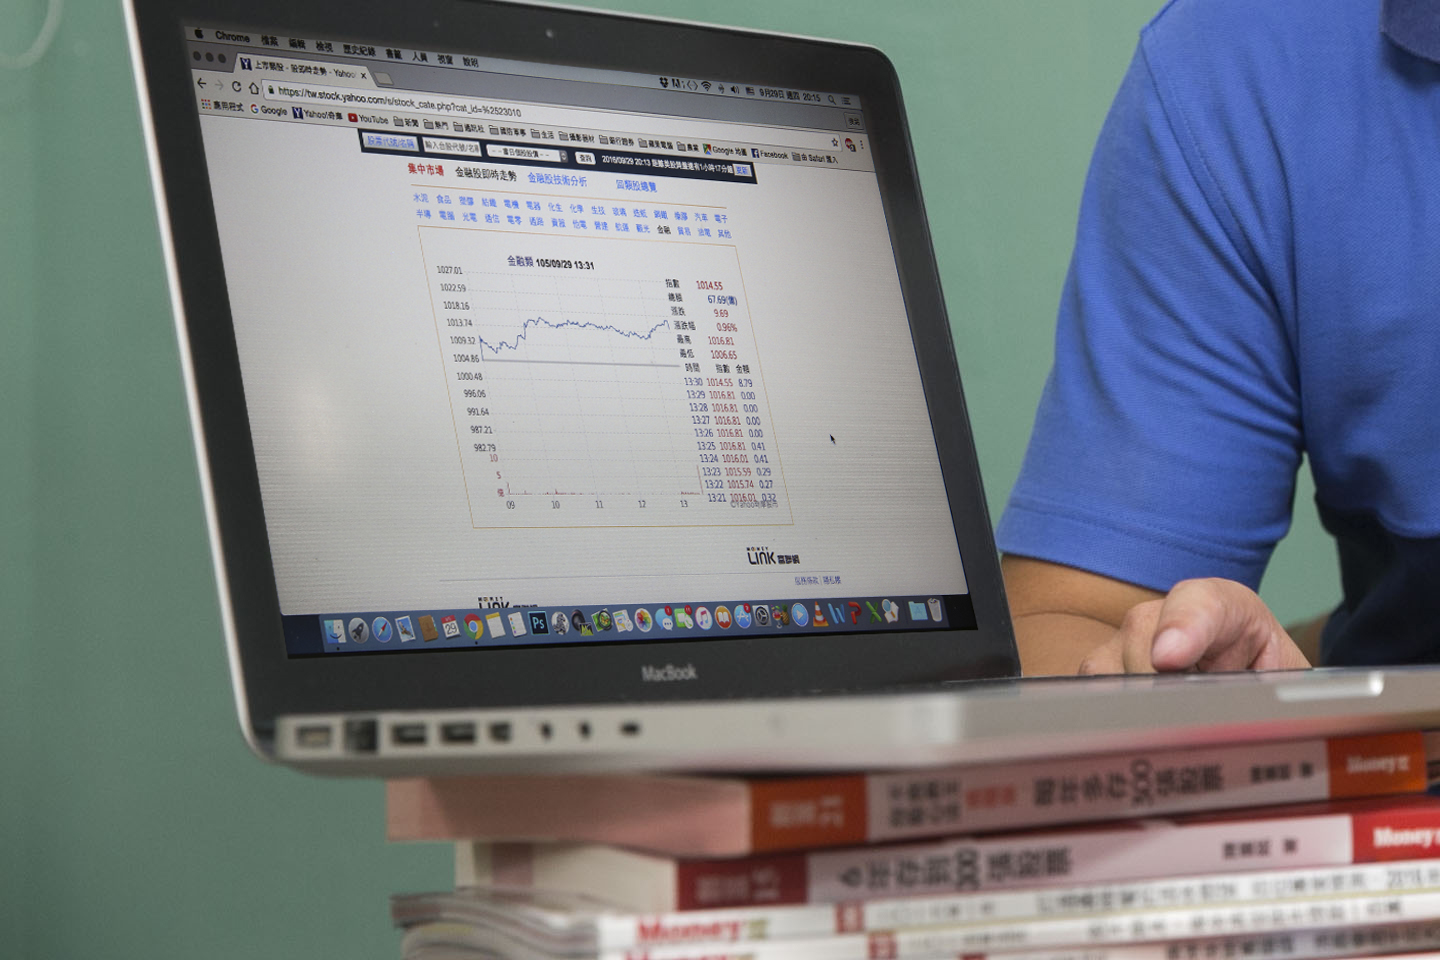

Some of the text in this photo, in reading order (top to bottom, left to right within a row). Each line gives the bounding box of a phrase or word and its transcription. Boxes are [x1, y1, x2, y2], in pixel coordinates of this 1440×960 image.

[214, 30, 250, 43] Chrome
[260, 35, 279, 46] 檔案
[288, 38, 306, 49] 編輯
[315, 41, 333, 52] 檢視
[410, 51, 428, 62] 人員
[436, 53, 453, 65] 視窗
[462, 56, 479, 67] 說明
[802, 92, 821, 102] 20:15
[212, 100, 244, 113] 應用程式
[260, 105, 288, 116] Google
[358, 113, 389, 125] YouTube
[711, 145, 734, 155] Google
[759, 149, 788, 159] Facebook
[807, 154, 825, 162] Safari
[601, 154, 634, 166] 2016/09/29
[633, 157, 651, 167] 20:13
[407, 162, 444, 176] 集中市場
[454, 166, 518, 182] 金融股即時走勢
[527, 171, 588, 187] 金融股技術分析
[412, 192, 429, 204] 水泥
[435, 194, 452, 205] 食品
[547, 202, 563, 213] 化生
[713, 213, 729, 224] 電子
[655, 224, 671, 234] 金融
[506, 255, 595, 270] 金融類 105/09/29 13:31
[436, 265, 463, 275] 1027.01
[439, 283, 466, 292] 1022.59
[664, 278, 723, 290] 指數 1014.55
[713, 308, 729, 317] 9.69
[446, 318, 473, 327] 1013.74
[715, 322, 738, 332] 0.96%
[449, 335, 476, 345] 1009.32
[707, 336, 734, 345] 1016.81
[452, 354, 480, 362] 1004.86
[710, 349, 738, 360] 1006.65
[456, 372, 483, 381] 1000.48
[683, 377, 753, 387] 13:30 1014.55 8.79
[462, 389, 486, 398] 996.06
[686, 389, 756, 400] 13:29 1016.81 0.00
[466, 407, 490, 416] 991.64
[688, 402, 759, 413] 13:28 1016.81 0.00
[691, 415, 761, 425] 13:27 1016.81 0.00
[469, 425, 493, 434] 987.21
[693, 428, 764, 438] 13:26 1016.81 0.00
[696, 441, 766, 450] 13:25 1016.81 0.41
[488, 453, 499, 462] 10
[699, 454, 769, 463] 13:24 1016.01 0.41
[701, 467, 772, 476] 13:23 1015.59 0.29
[704, 479, 774, 489] 13:22 1015.74 0.27
[706, 493, 777, 502] 13:21 1016.01 0.32
[505, 499, 689, 509] 09 10 11 12 13
[444, 622, 457, 634] 29
[532, 617, 545, 629] Ps
[641, 664, 698, 681] MacBook
